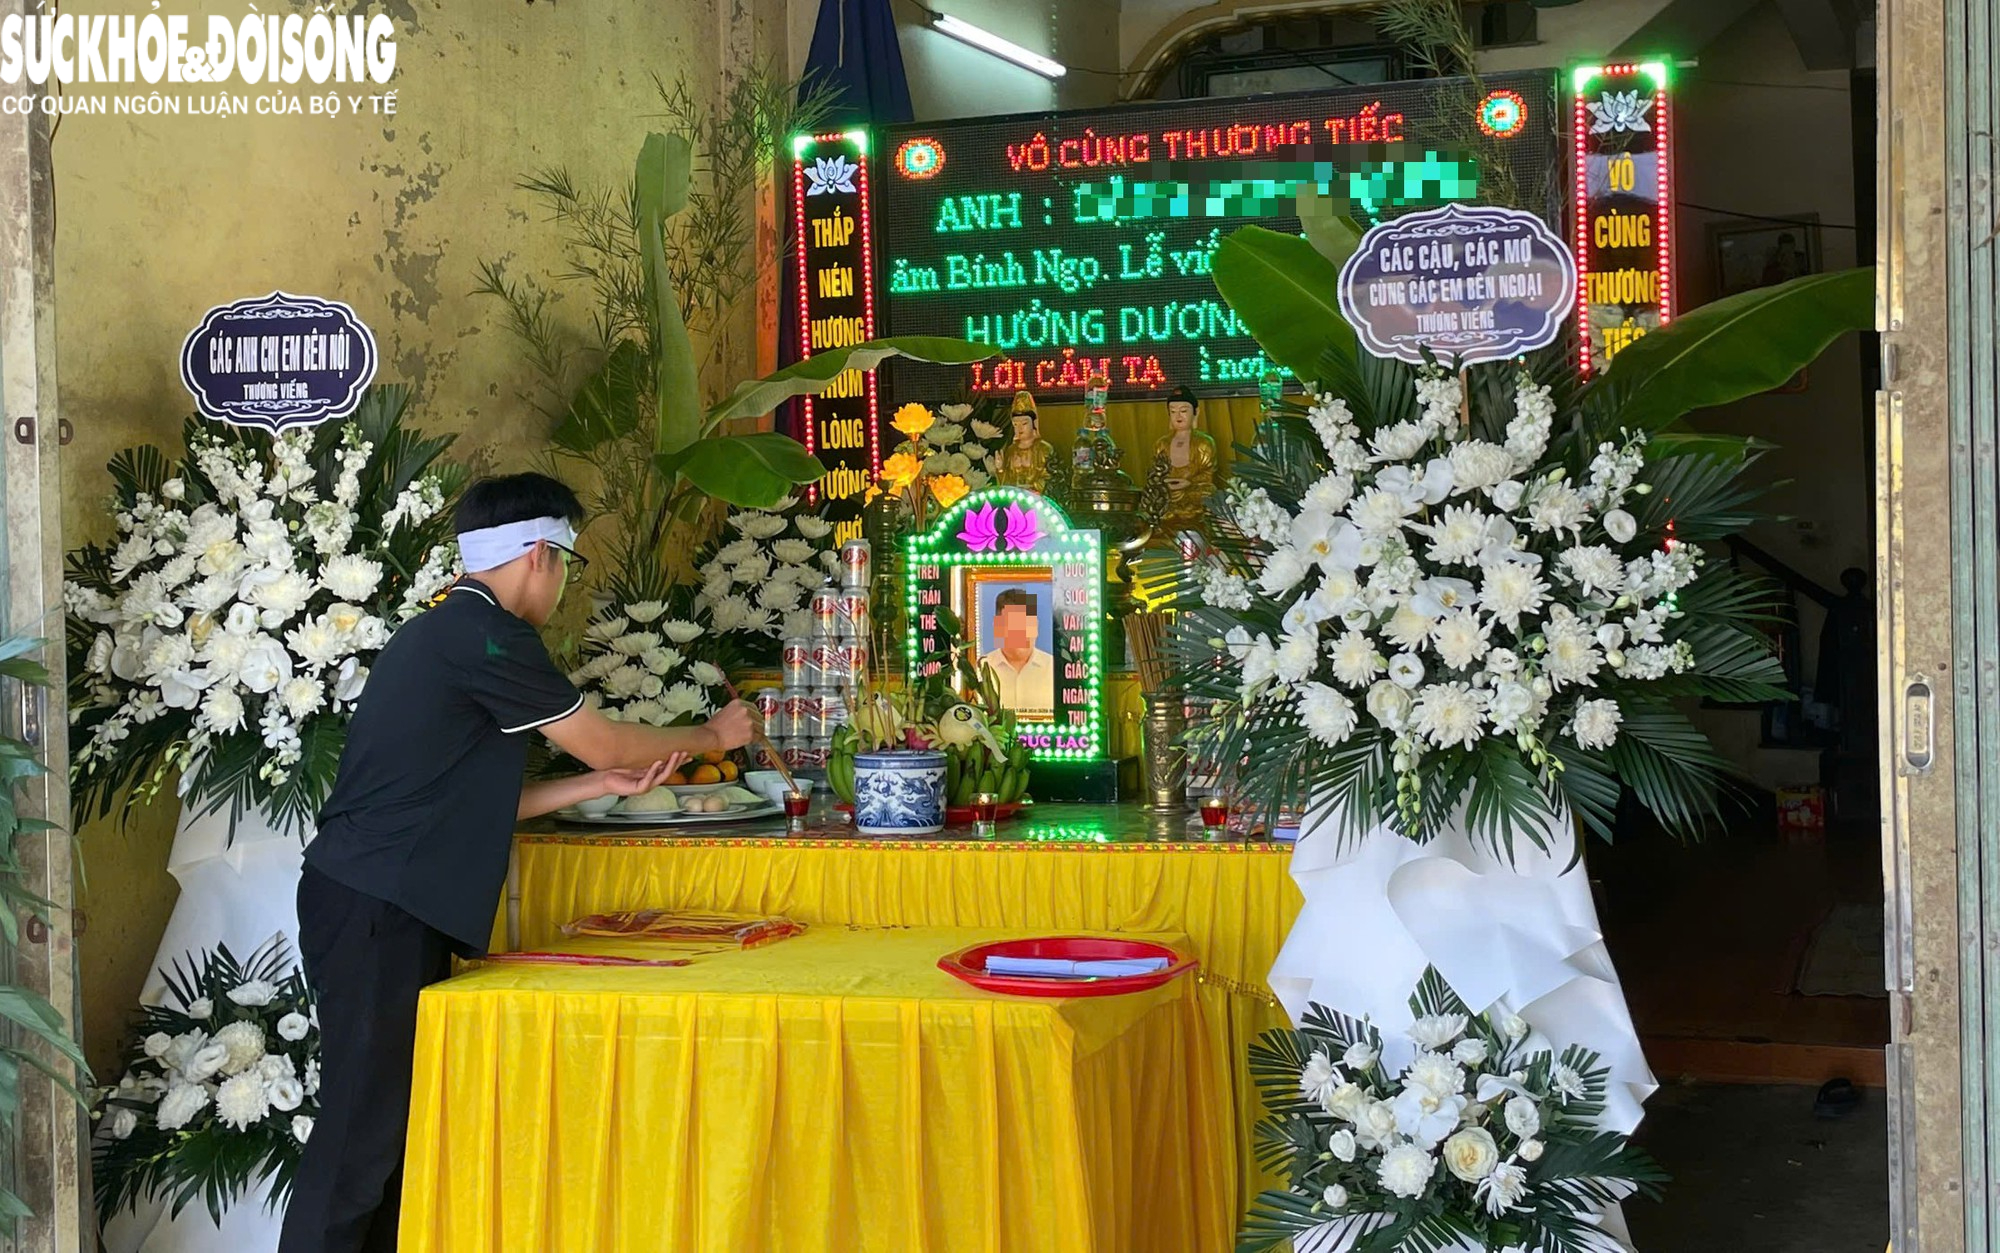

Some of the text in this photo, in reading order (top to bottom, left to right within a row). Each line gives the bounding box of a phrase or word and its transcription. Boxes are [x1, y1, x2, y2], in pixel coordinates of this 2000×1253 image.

[1007, 100, 1404, 172] VÔ CÙNG THƯƠNG TIẾC
[1608, 152, 1635, 193] VÔ
[812, 206, 854, 248] THẮP
[936, 193, 1023, 233] ANH
[1594, 209, 1650, 248] CÙNG
[1380, 235, 1533, 275] CÁC CẬU, CÁC MỢ
[819, 262, 854, 298] NÉN
[1369, 272, 1542, 307] CÙNG CÁC EM BÊN NGOẠI
[1586, 268, 1662, 305] THƯƠNG
[811, 315, 865, 349] HƯƠNG
[967, 299, 1104, 348] HƯỞNG
[1416, 306, 1494, 333] THƯƠNG VIẾNG
[209, 327, 350, 379] CÁC ANH CHỊ EM BÊN NỘI
[243, 379, 308, 401] THƯƠNG VIẾNG
[821, 412, 864, 449] LÒNG
